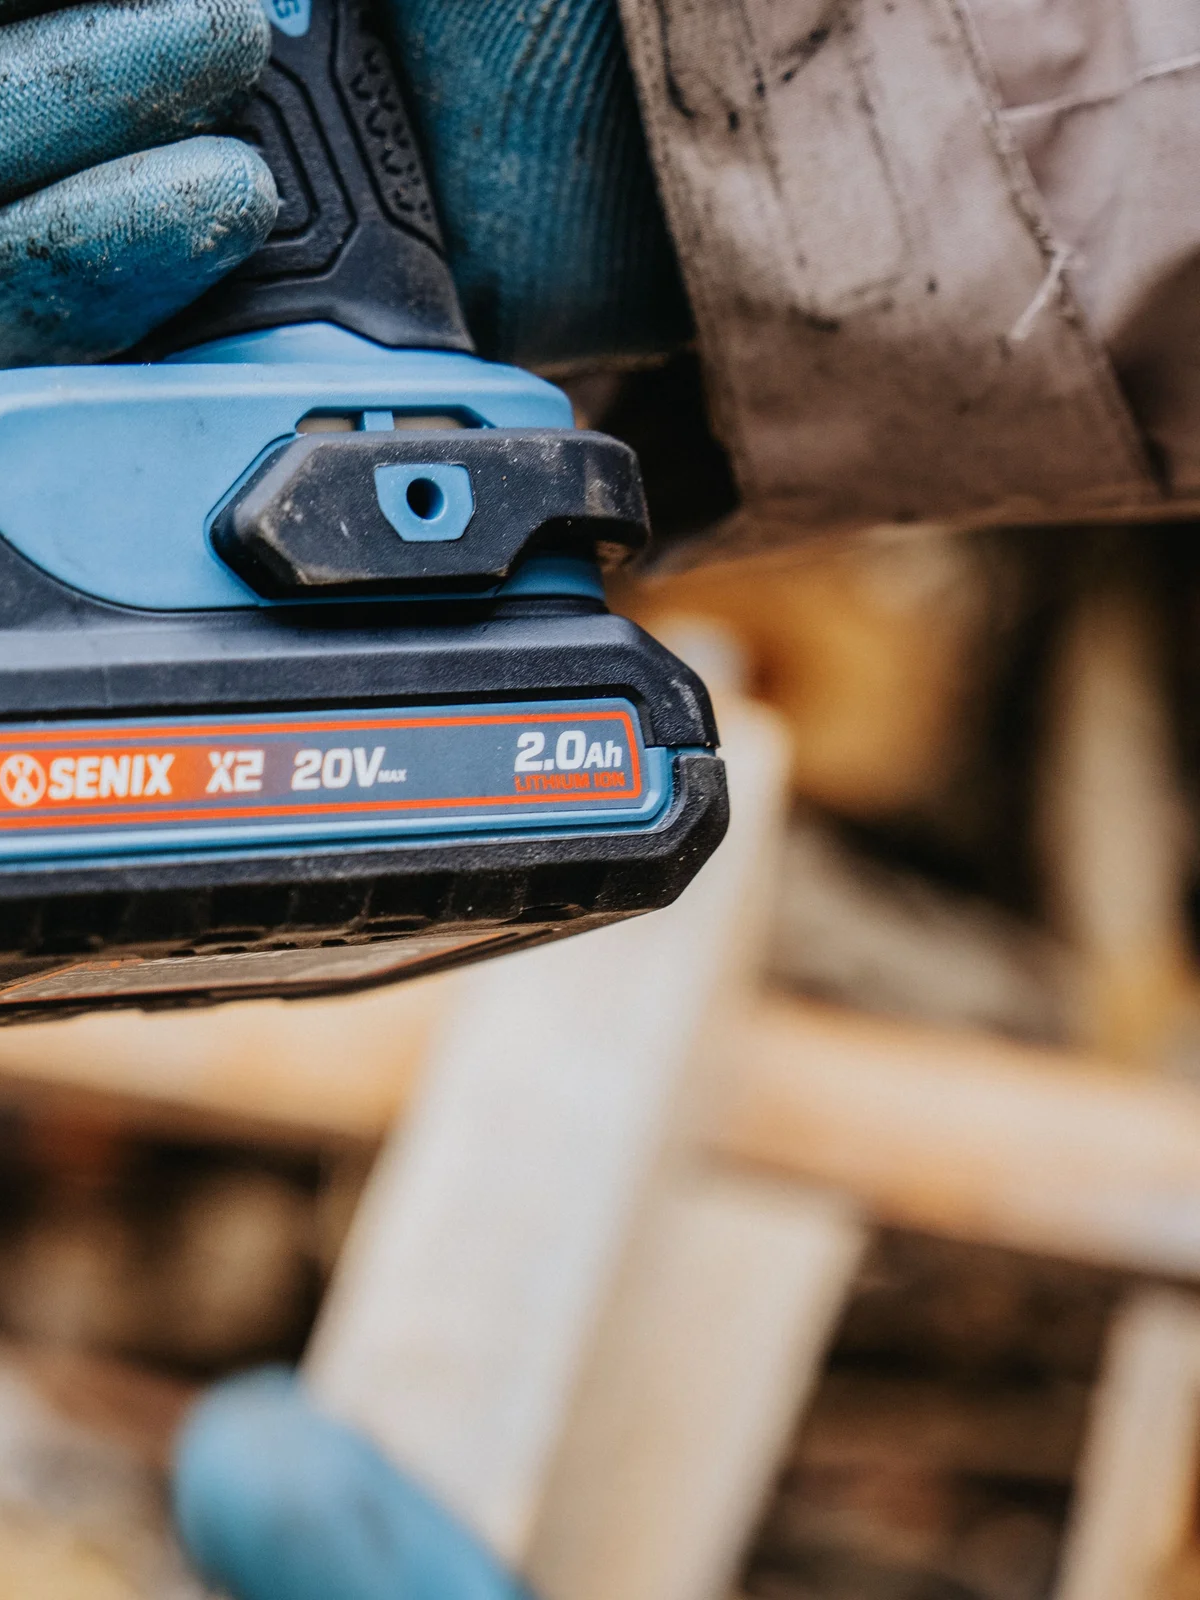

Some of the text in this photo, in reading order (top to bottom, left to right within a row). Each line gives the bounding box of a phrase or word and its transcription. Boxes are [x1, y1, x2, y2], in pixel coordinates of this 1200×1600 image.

[514, 730, 623, 772] 2.0Ah
[50, 753, 174, 799] SENIX
[205, 750, 264, 793] X2
[514, 771, 625, 792] LITHIUM ION
